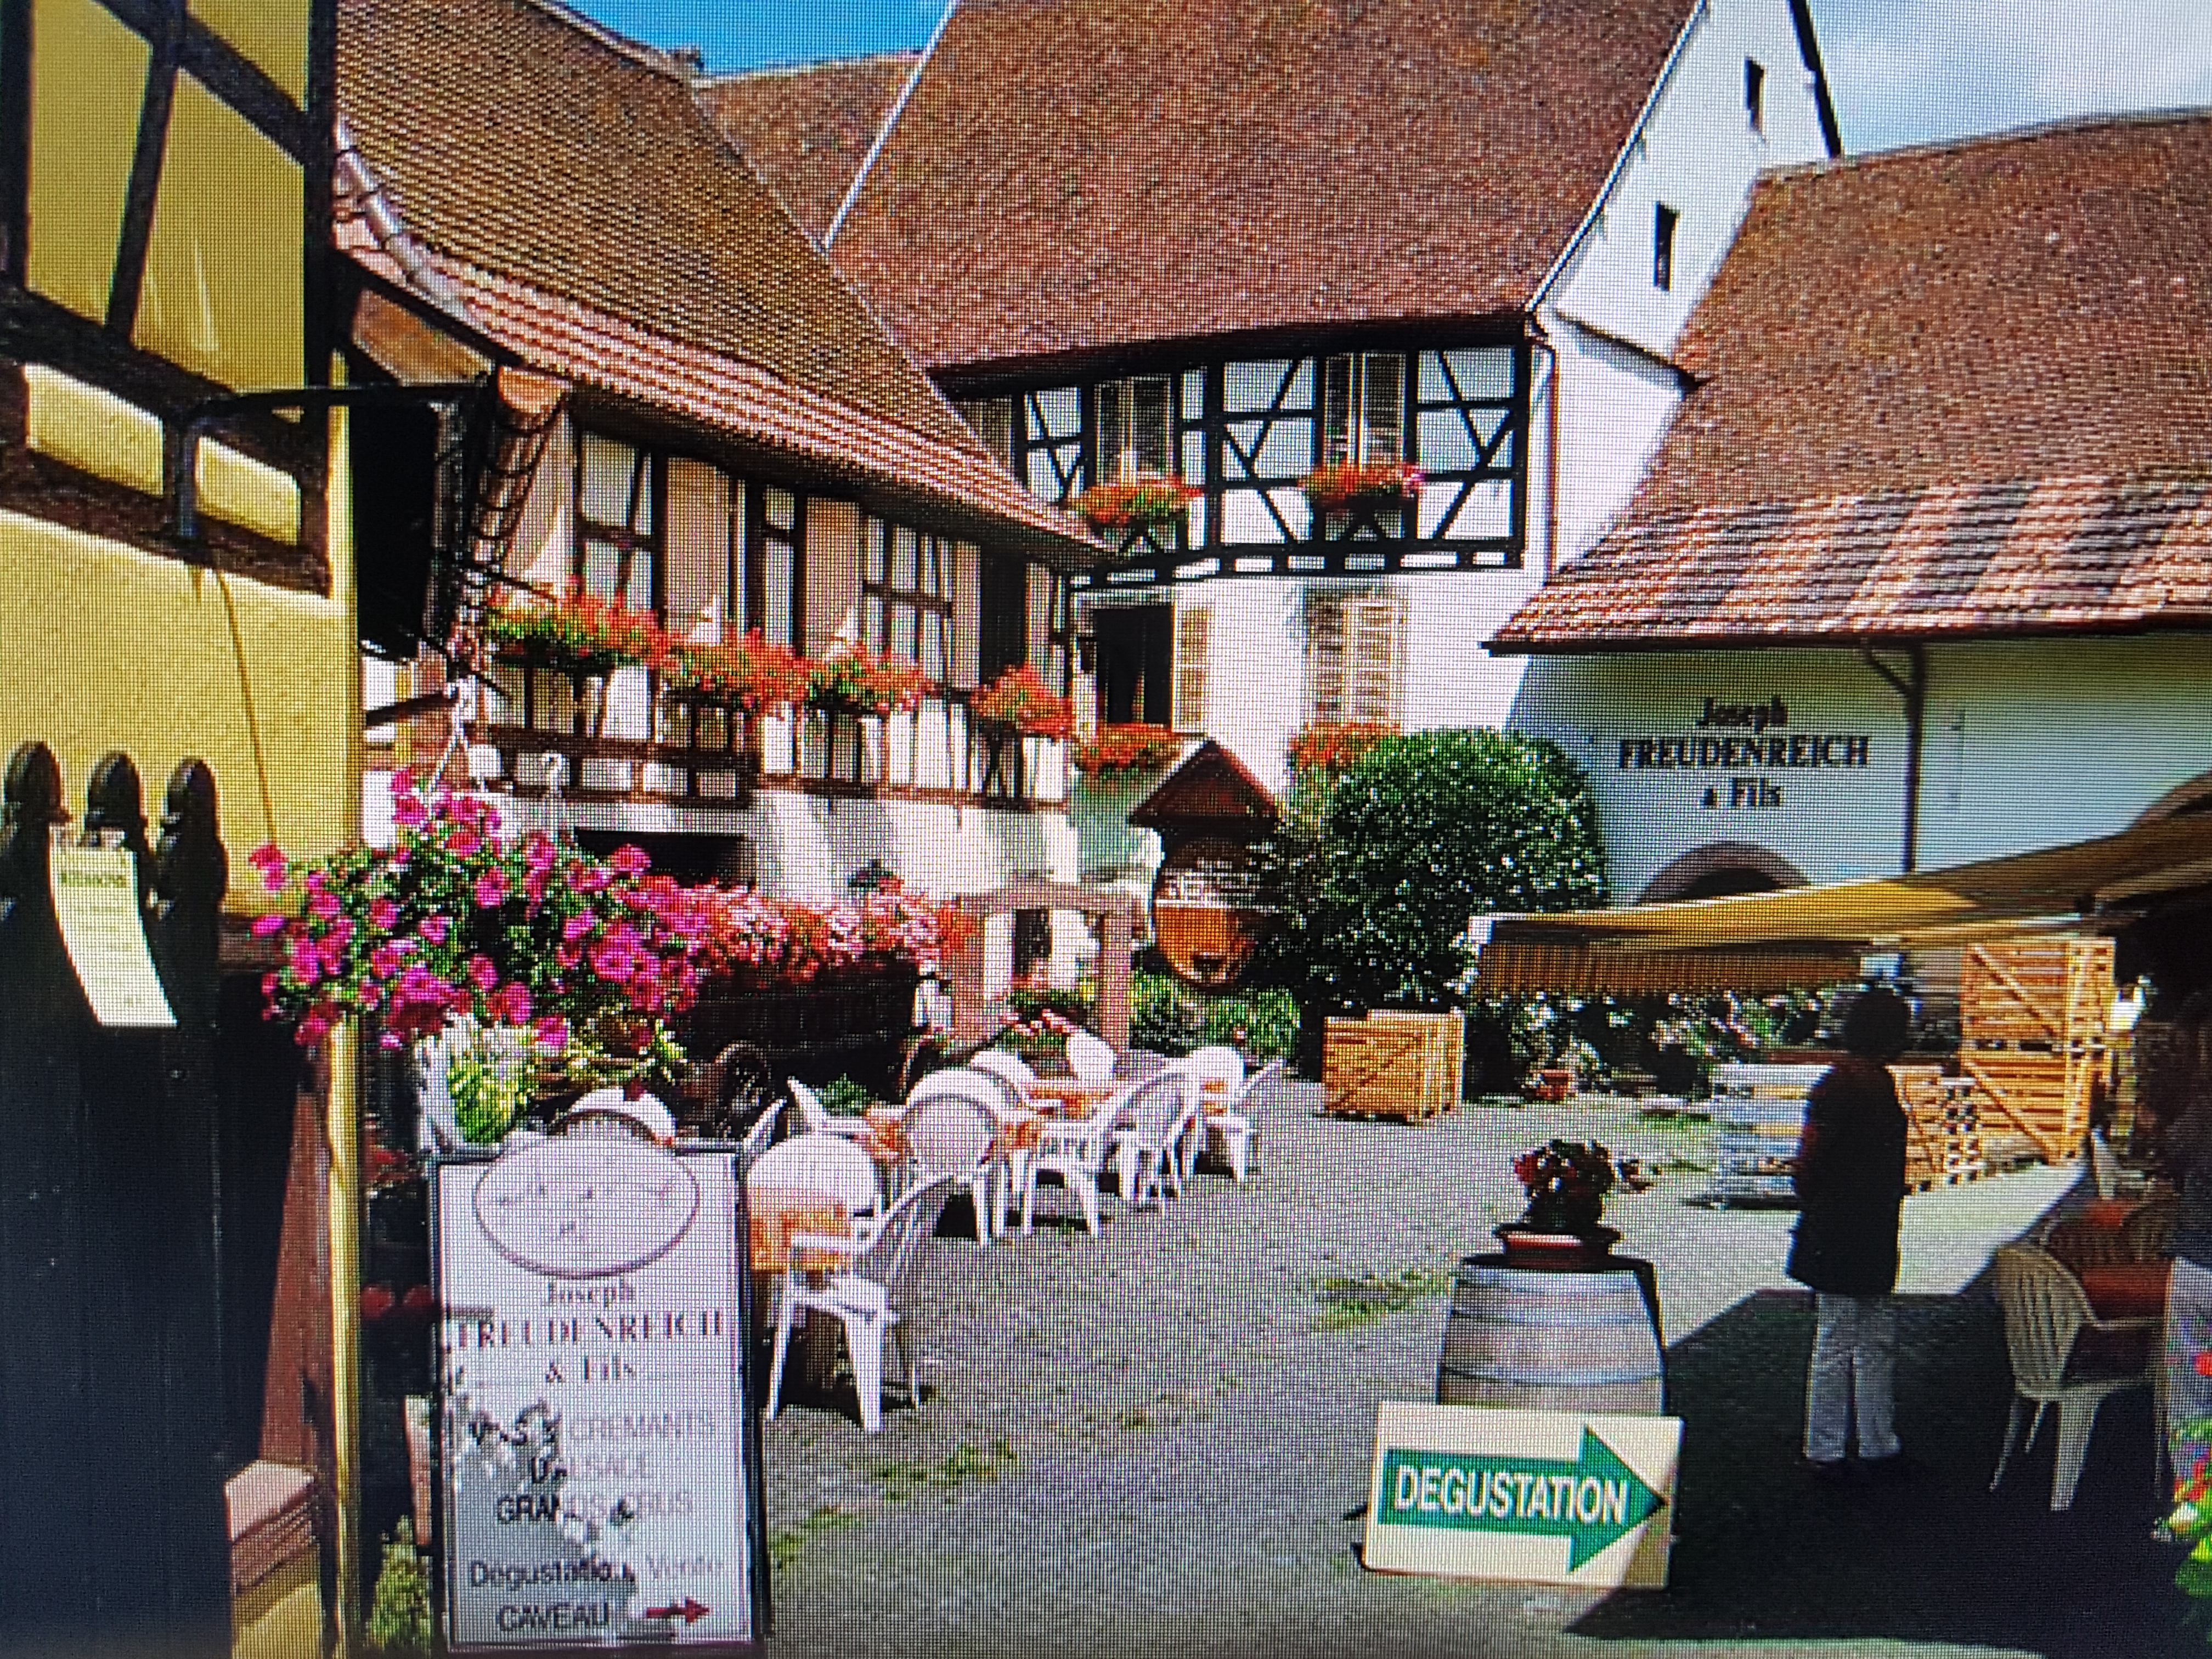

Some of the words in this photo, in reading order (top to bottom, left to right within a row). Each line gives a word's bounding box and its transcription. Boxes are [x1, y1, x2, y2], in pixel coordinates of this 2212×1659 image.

[1695, 693, 1790, 732] Joseph
[1618, 734, 1871, 769] FREUDENREICH
[1729, 776, 1784, 809] Fils
[541, 1278, 636, 1309] Joseph
[543, 1356, 566, 1385] &
[580, 1352, 638, 1384] Fils
[1394, 1464, 1631, 1526] DEGUSTATION
[495, 1600, 611, 1634] CAVEAU
